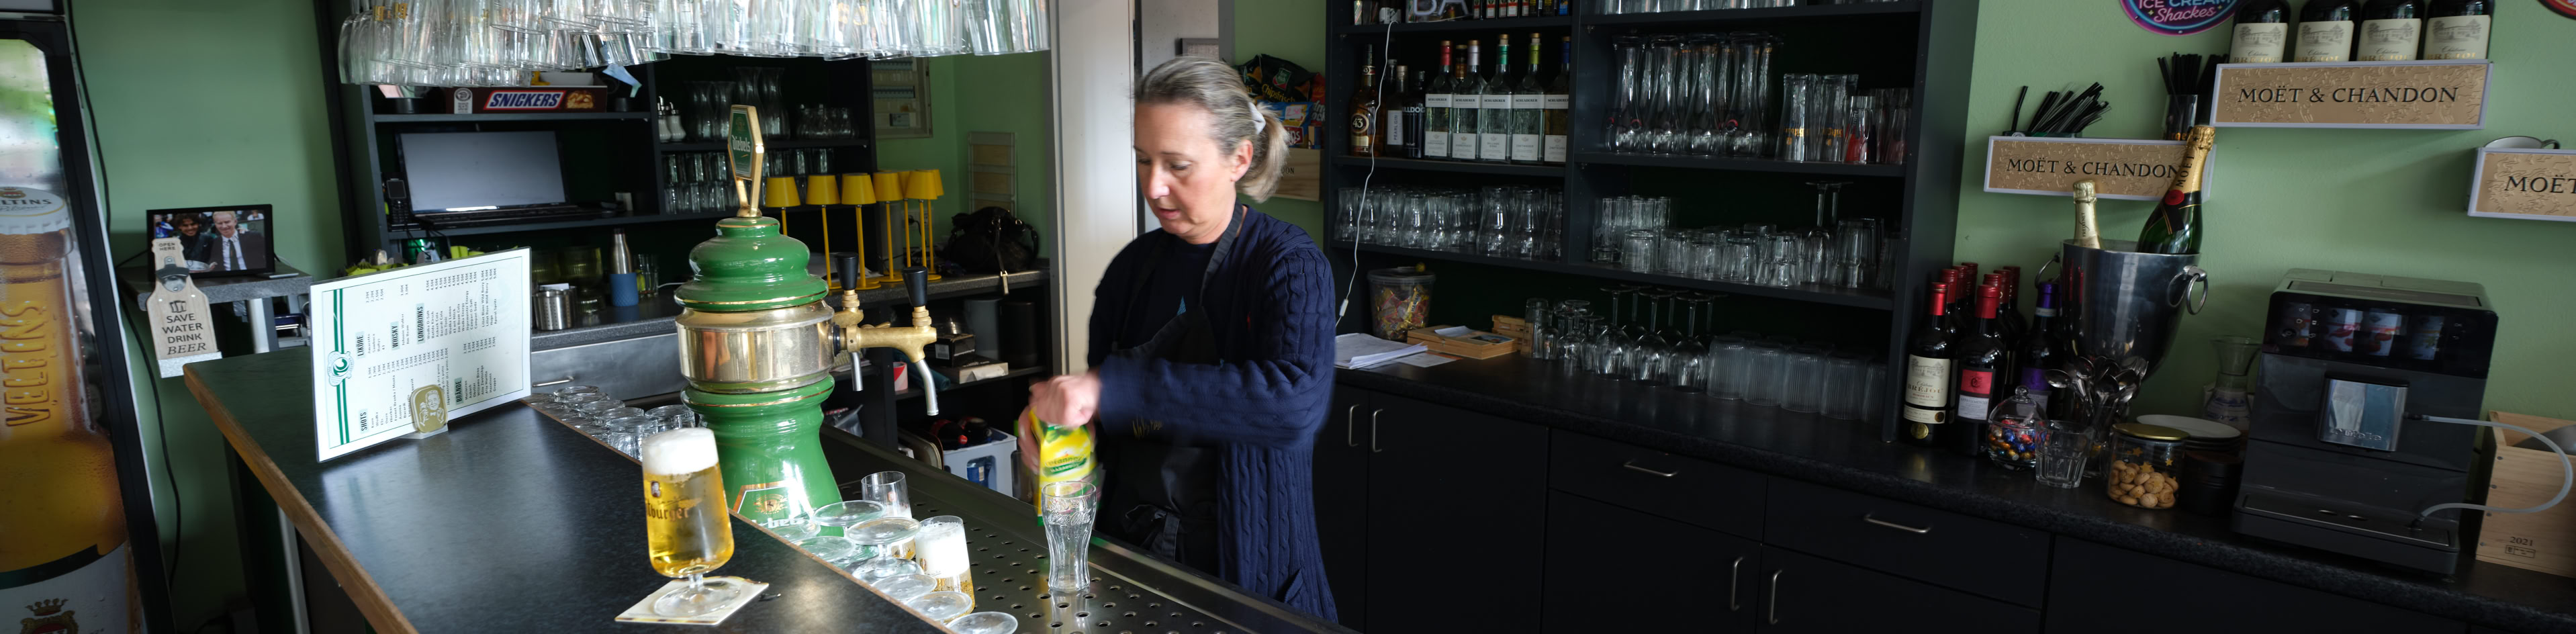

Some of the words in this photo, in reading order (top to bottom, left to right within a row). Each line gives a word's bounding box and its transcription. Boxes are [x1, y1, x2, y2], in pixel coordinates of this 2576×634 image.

[2154, 6, 2216, 22] Shackes
[489, 93, 561, 107] SNICKERS
[2238, 85, 2303, 103] MOËT
[2309, 88, 2325, 103] &
[2332, 87, 2458, 103] CHANDON
[1352, 118, 1364, 128] 43
[2007, 157, 2059, 173] MOËT
[2064, 161, 2076, 174] &
[2082, 162, 2179, 179] CHANDON
[2504, 175, 2576, 193] MOËT
[167, 313, 195, 324] SAVE
[161, 322, 203, 334] WATER
[167, 333, 202, 344] DRINK
[167, 343, 207, 355] BEER
[0, 301, 50, 426] VELTINS
[647, 499, 688, 522] tburger
[2509, 536, 2533, 546] 2021
